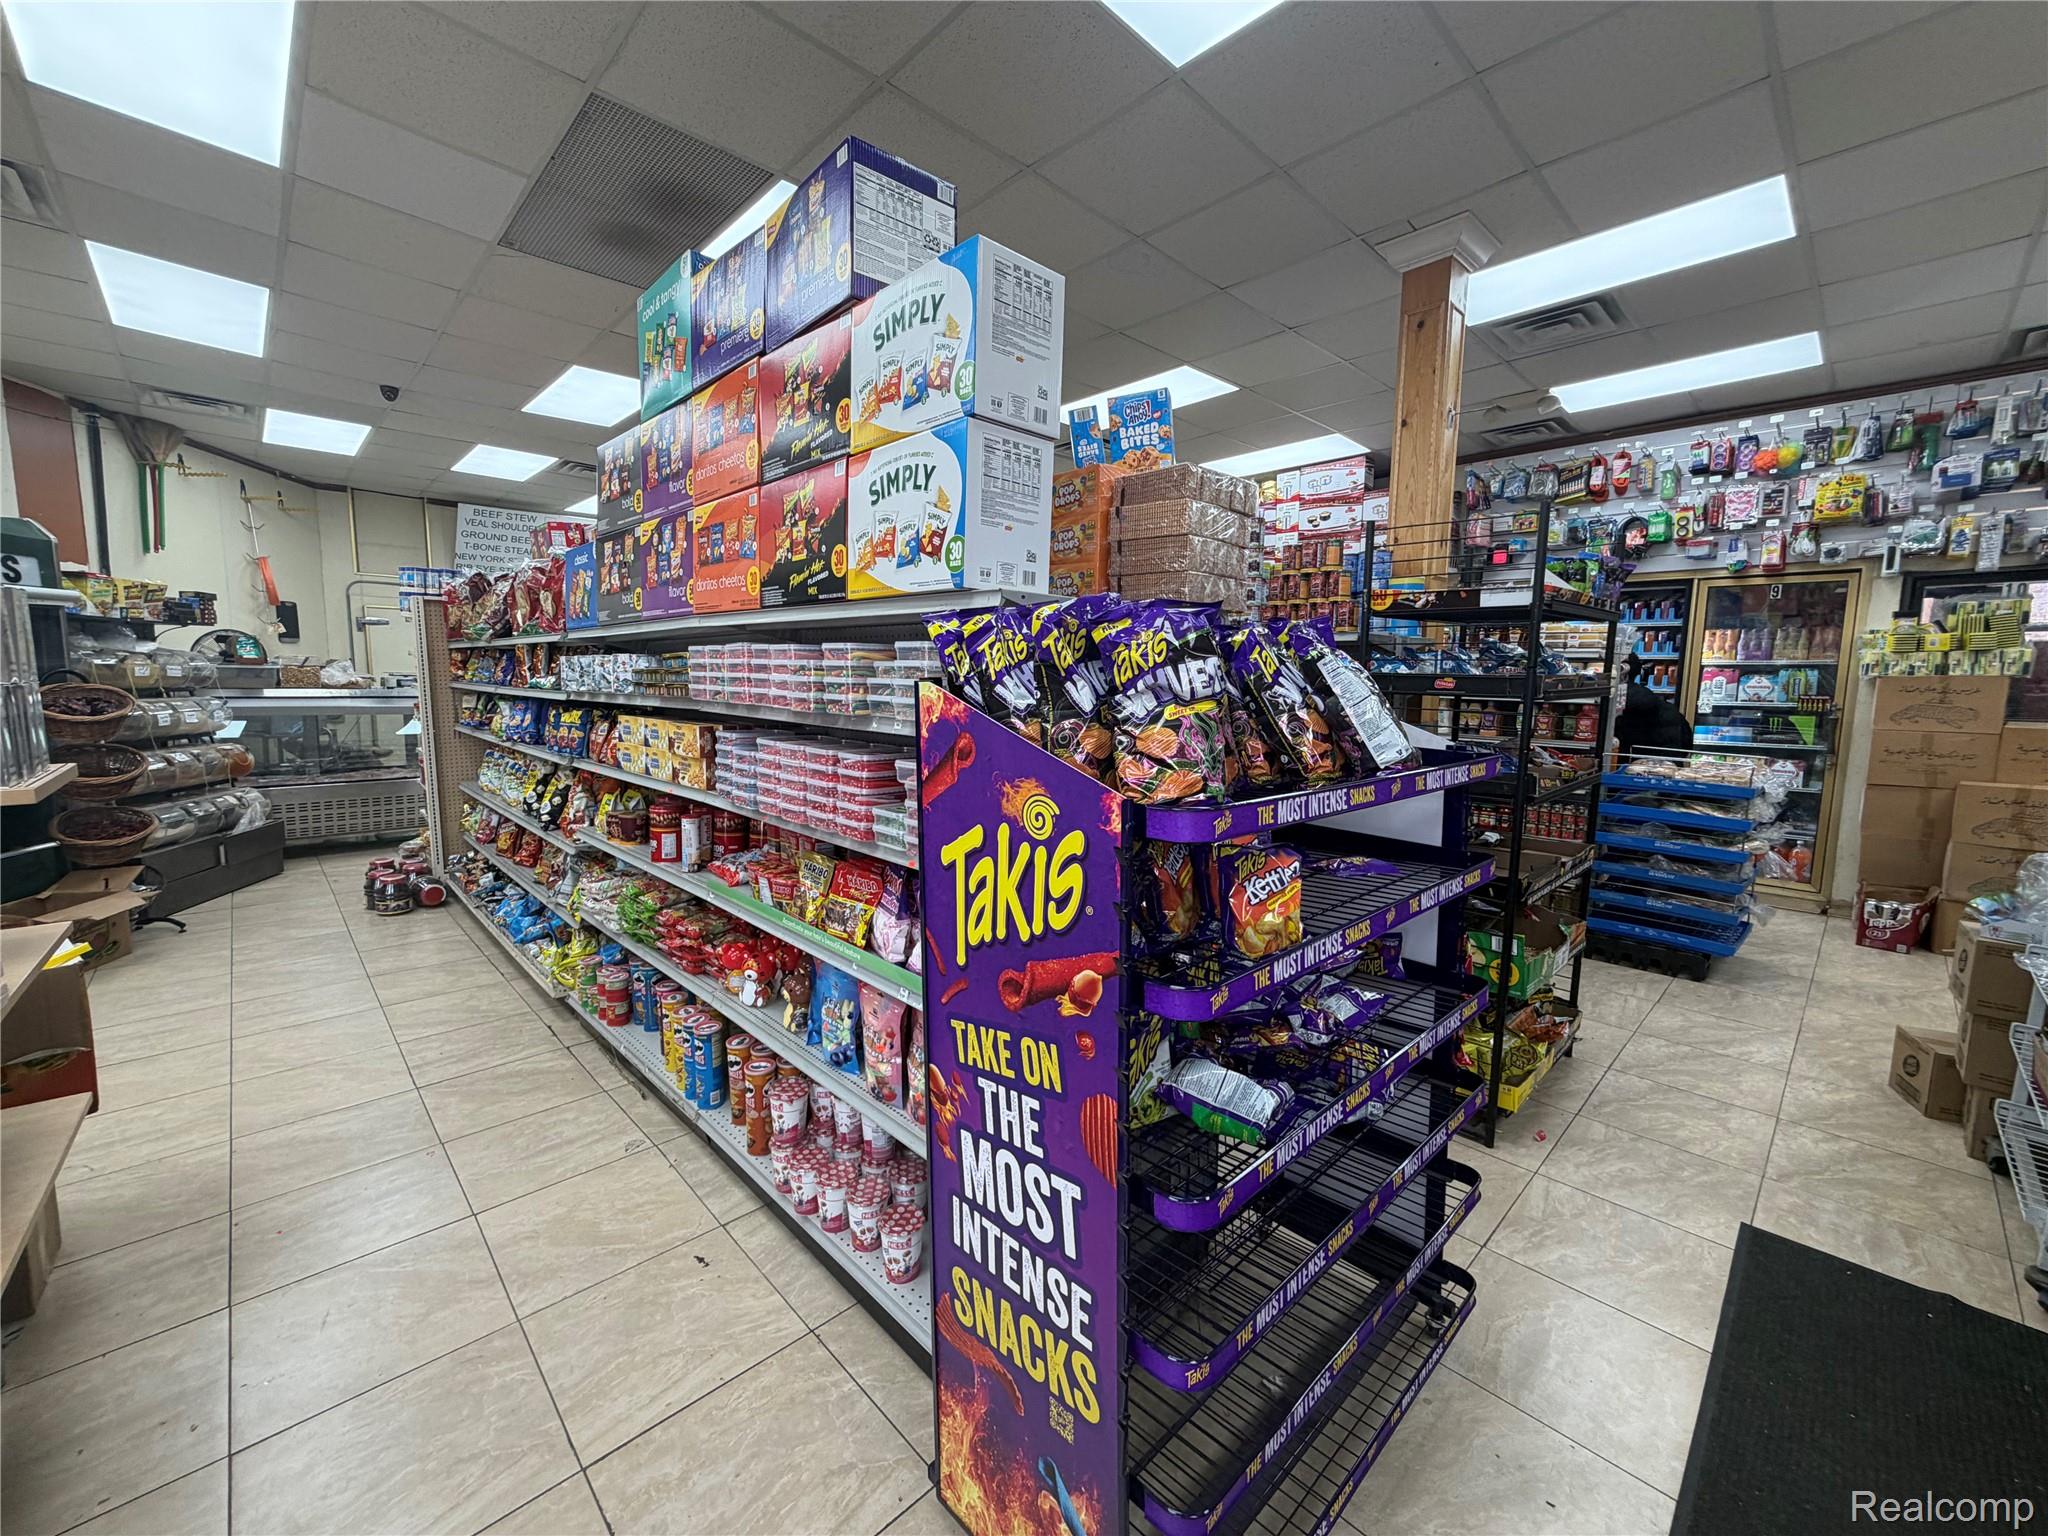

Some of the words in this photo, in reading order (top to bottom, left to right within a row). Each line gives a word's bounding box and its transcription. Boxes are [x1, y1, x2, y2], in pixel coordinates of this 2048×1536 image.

[642, 302, 654, 322] cool
[655, 296, 661, 312] &
[661, 280, 682, 308] tangy
[872, 293, 945, 352] SIMPLY
[936, 343, 955, 353] SIMPLY
[882, 360, 900, 370] SIMPLY
[906, 359, 923, 374] SIMPLY
[960, 366, 973, 388] 30
[859, 378, 874, 396] SIMPLY
[839, 404, 849, 422] 30
[1124, 401, 1146, 416] Chips
[810, 429, 833, 447] FLAVORED
[1120, 422, 1159, 439] BAKED
[1120, 434, 1160, 450] BITES
[696, 462, 717, 480] doritos
[718, 451, 745, 472] cheetos
[669, 479, 685, 493] flavor
[869, 464, 936, 507] SIMPLY
[1059, 484, 1075, 495] POP
[622, 495, 634, 508] bold
[1055, 491, 1080, 507] DROPS
[465, 518, 488, 528] VEAL
[473, 508, 502, 519] BEEF
[506, 512, 537, 522] STEW
[928, 512, 945, 525] SIMPLY
[461, 530, 508, 542] GROUND
[511, 536, 530, 544] BEE
[856, 531, 870, 544] SIMPLY
[900, 523, 916, 535] SIMPLY
[1058, 531, 1074, 541] POP
[464, 542, 503, 552] T-BONE
[504, 546, 532, 555] STEA
[950, 541, 962, 559] 30
[1054, 539, 1079, 552] DROPS
[455, 552, 477, 560] NEW
[479, 554, 505, 563] YORK
[574, 551, 589, 566] classic
[834, 550, 844, 566] 30
[696, 578, 718, 592] doritos
[718, 575, 746, 590] cheetos
[808, 571, 829, 585] FLAVORED
[1056, 578, 1072, 588] POP
[622, 593, 634, 604] bold
[668, 586, 686, 598] flavor
[1771, 585, 1780, 598] 9
[977, 630, 1027, 681] Takis
[1042, 622, 1087, 677] Takis
[1112, 631, 1167, 691] Takis
[1415, 775, 1425, 791] THE
[1426, 769, 1444, 791] MOST
[1445, 764, 1469, 786] INTENSE
[1470, 762, 1486, 779] SNACKS
[1257, 804, 1274, 827] THE
[1278, 795, 1306, 825] MOST
[1308, 788, 1348, 818] INTENSE
[1350, 785, 1375, 806] SNACKS
[1213, 810, 1233, 838] Takis
[804, 860, 828, 879] HARIBO
[1235, 850, 1266, 883] Takis
[846, 874, 878, 892] HARIBO
[940, 795, 1086, 967] Takis
[1409, 896, 1419, 914] THE
[1421, 886, 1438, 910] MOST
[1439, 876, 1463, 902] INTENSE
[1464, 869, 1480, 888] SNACKS
[1253, 966, 1270, 991] THE
[1273, 950, 1303, 984] MOST
[1304, 931, 1343, 968] INTENSE
[1345, 920, 1371, 945] SNACKS
[1210, 985, 1229, 1015] Takis
[950, 1018, 1016, 1080] TAKE
[1022, 1035, 1063, 1095] ON
[977, 1076, 1044, 1160] THE
[1258, 1158, 1274, 1183] THE
[1276, 1130, 1304, 1170] MOST
[1306, 1100, 1344, 1146] INTENSE
[1345, 1080, 1371, 1112] SNACKS
[960, 1128, 1082, 1261] MOST
[952, 1194, 1094, 1352] INTENSE
[1236, 1320, 1254, 1351] THE
[1256, 1291, 1284, 1333] MOST
[1287, 1251, 1327, 1302] INTENSE
[1328, 1219, 1354, 1257] SNACKS
[951, 1265, 1101, 1425] SNACKS
[1185, 1362, 1210, 1388] Takis
[1246, 1452, 1262, 1484] THE
[1264, 1416, 1292, 1463] MOST
[1294, 1370, 1332, 1426] INTENSE
[1333, 1335, 1358, 1375] SNACKS
[1329, 1477, 1354, 1522] SNACKS
